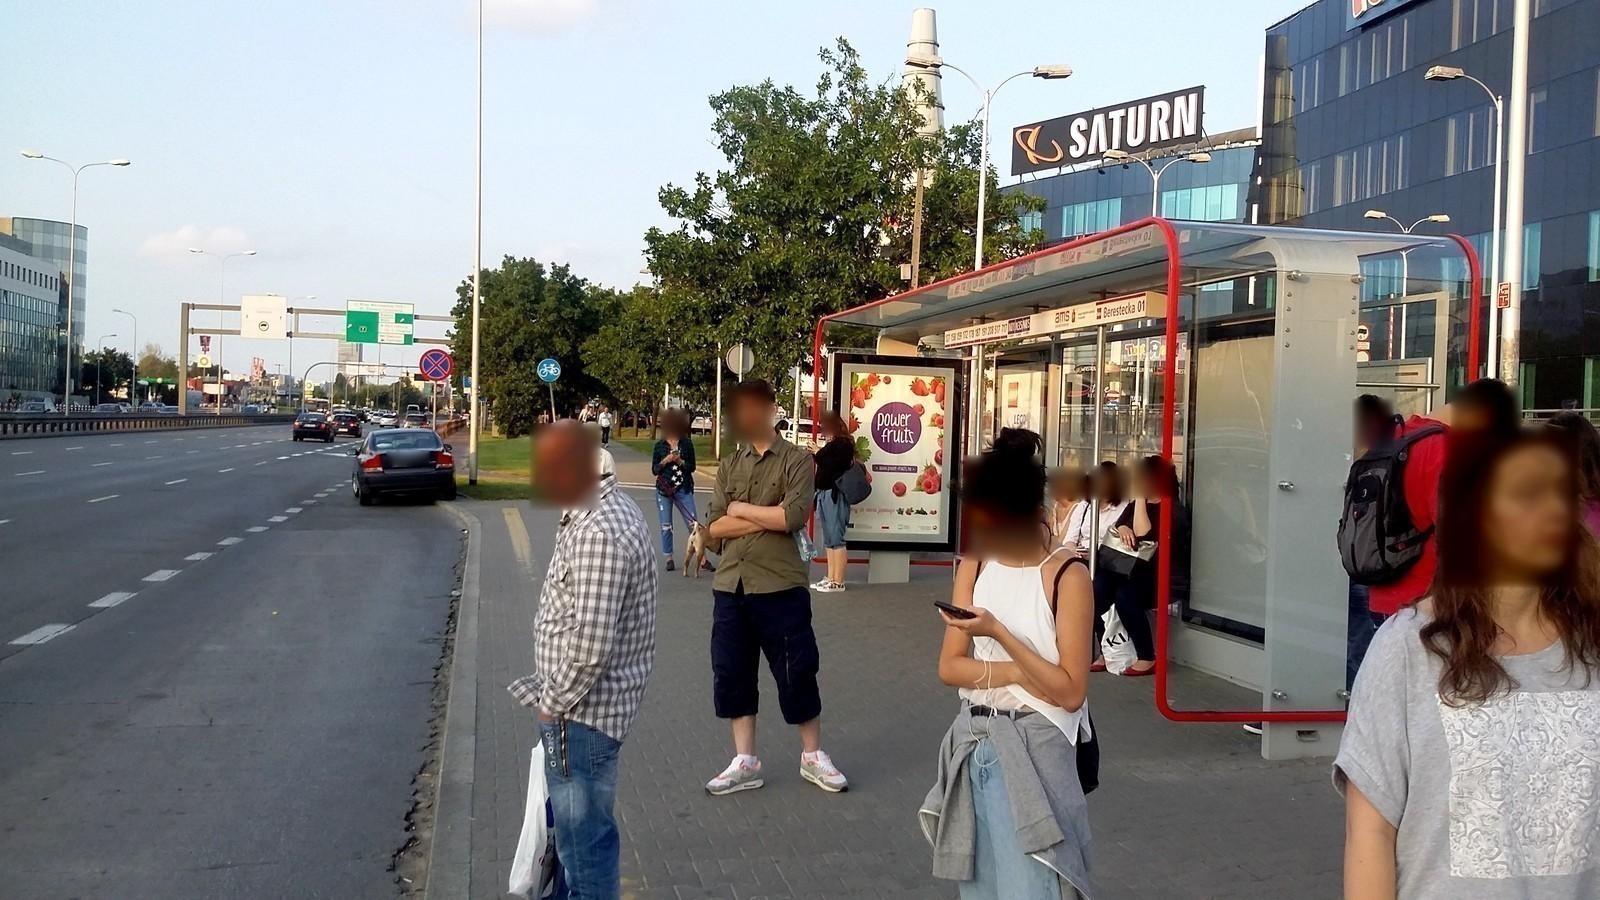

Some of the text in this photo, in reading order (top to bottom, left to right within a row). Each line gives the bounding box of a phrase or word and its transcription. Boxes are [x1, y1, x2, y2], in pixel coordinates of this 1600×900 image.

[1069, 93, 1198, 158] SATURN
[1055, 310, 1070, 323] ams
[1103, 303, 1136, 319] Berestecka
[1137, 300, 1145, 313] 01
[877, 412, 912, 431] power
[881, 427, 914, 444] fruits
